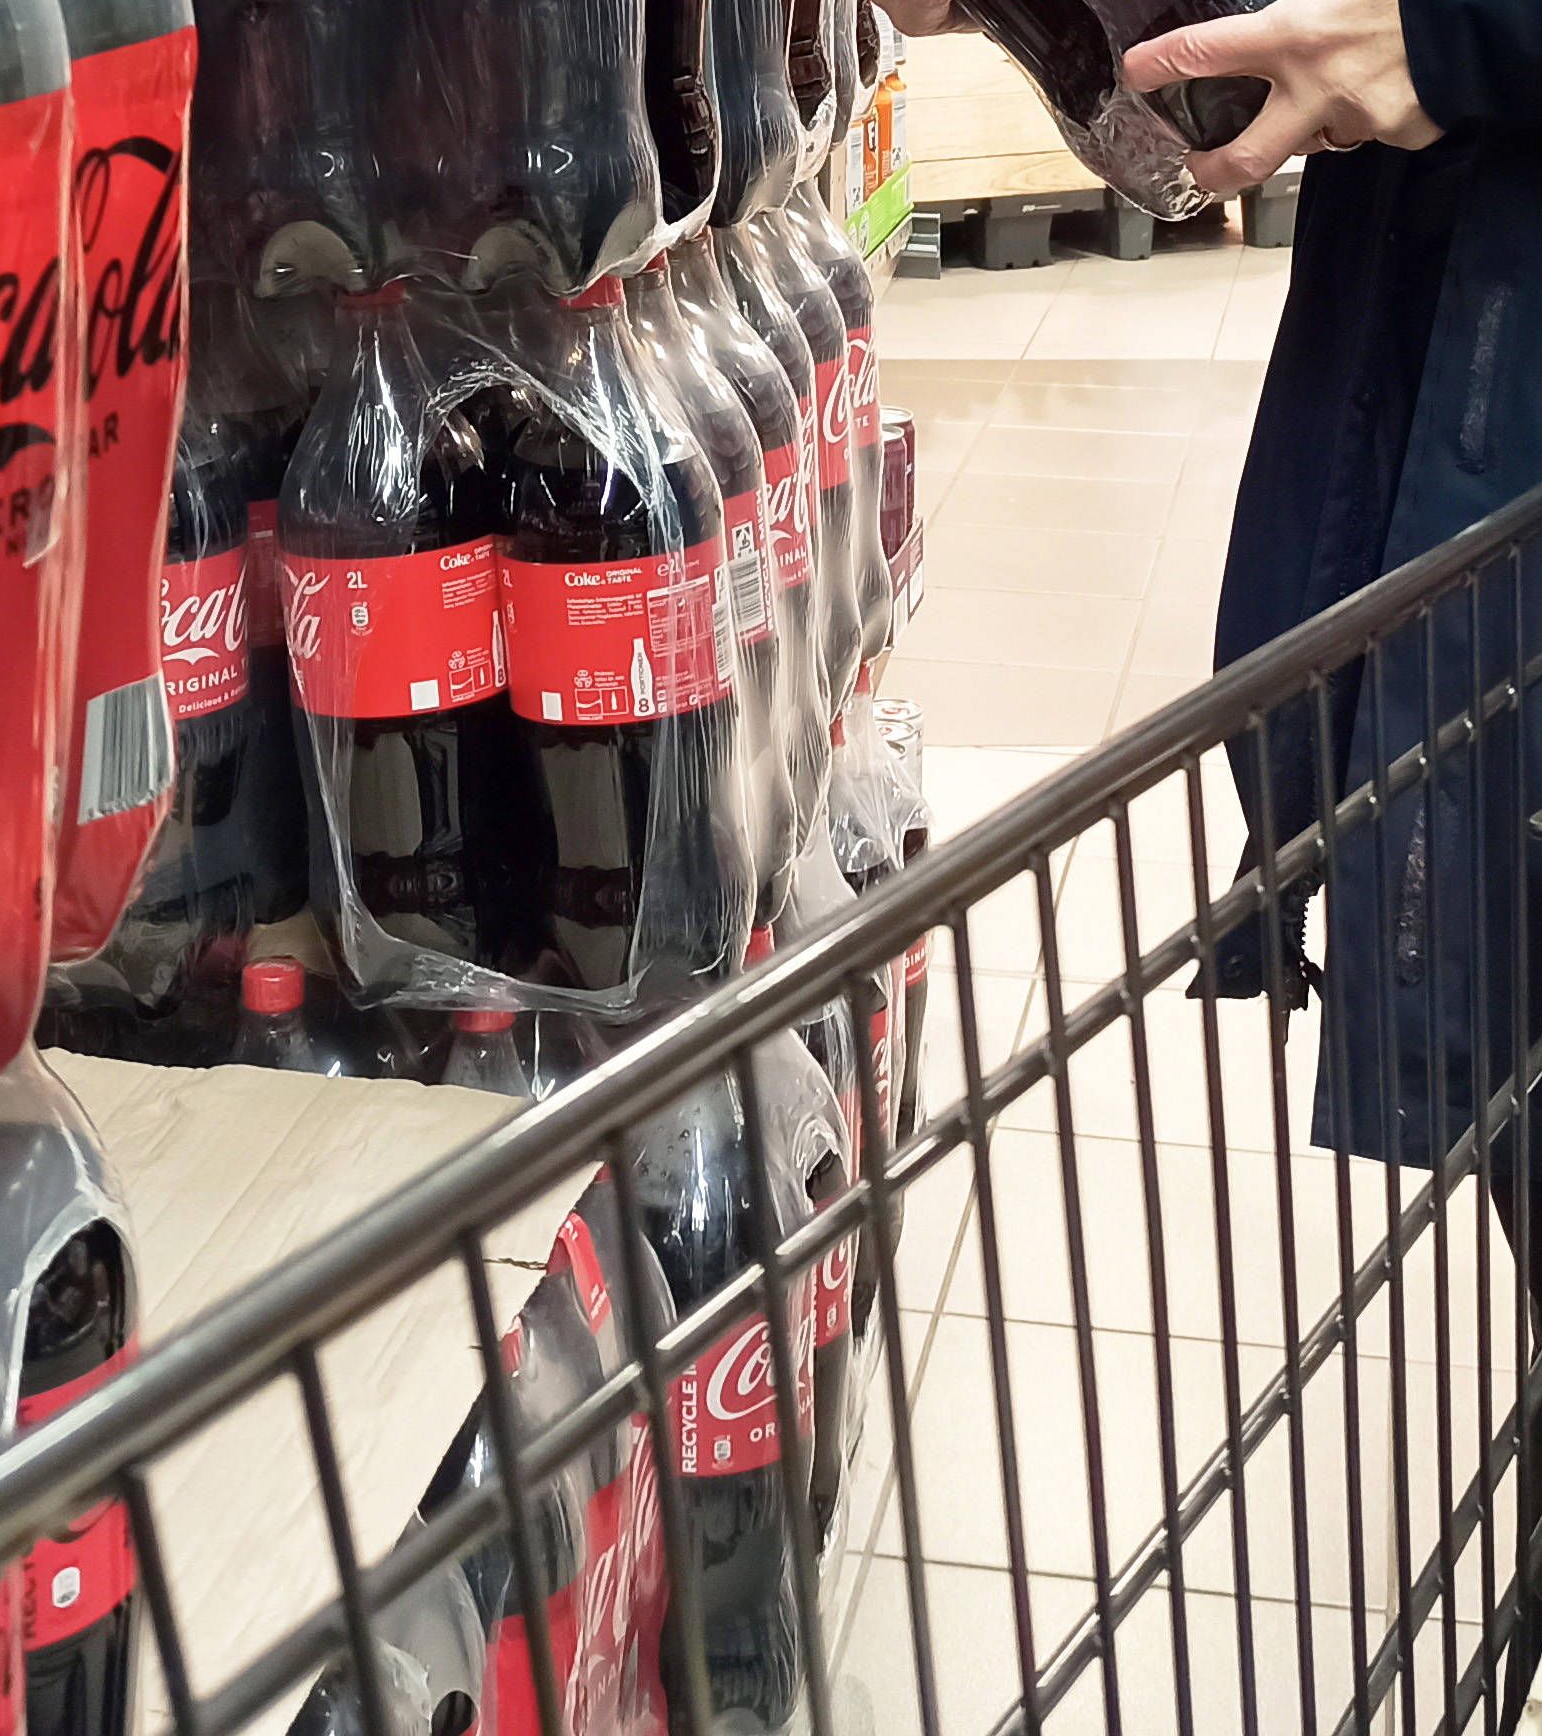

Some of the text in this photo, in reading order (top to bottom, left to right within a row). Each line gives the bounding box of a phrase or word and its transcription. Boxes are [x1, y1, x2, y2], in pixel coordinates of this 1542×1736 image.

[439, 552, 472, 571] Coke
[346, 570, 368, 589] 2L
[564, 571, 602, 587] Coke
[165, 664, 238, 696] RIGINAL
[638, 697, 650, 713] 8
[681, 1379, 698, 1474] RECYCLE
